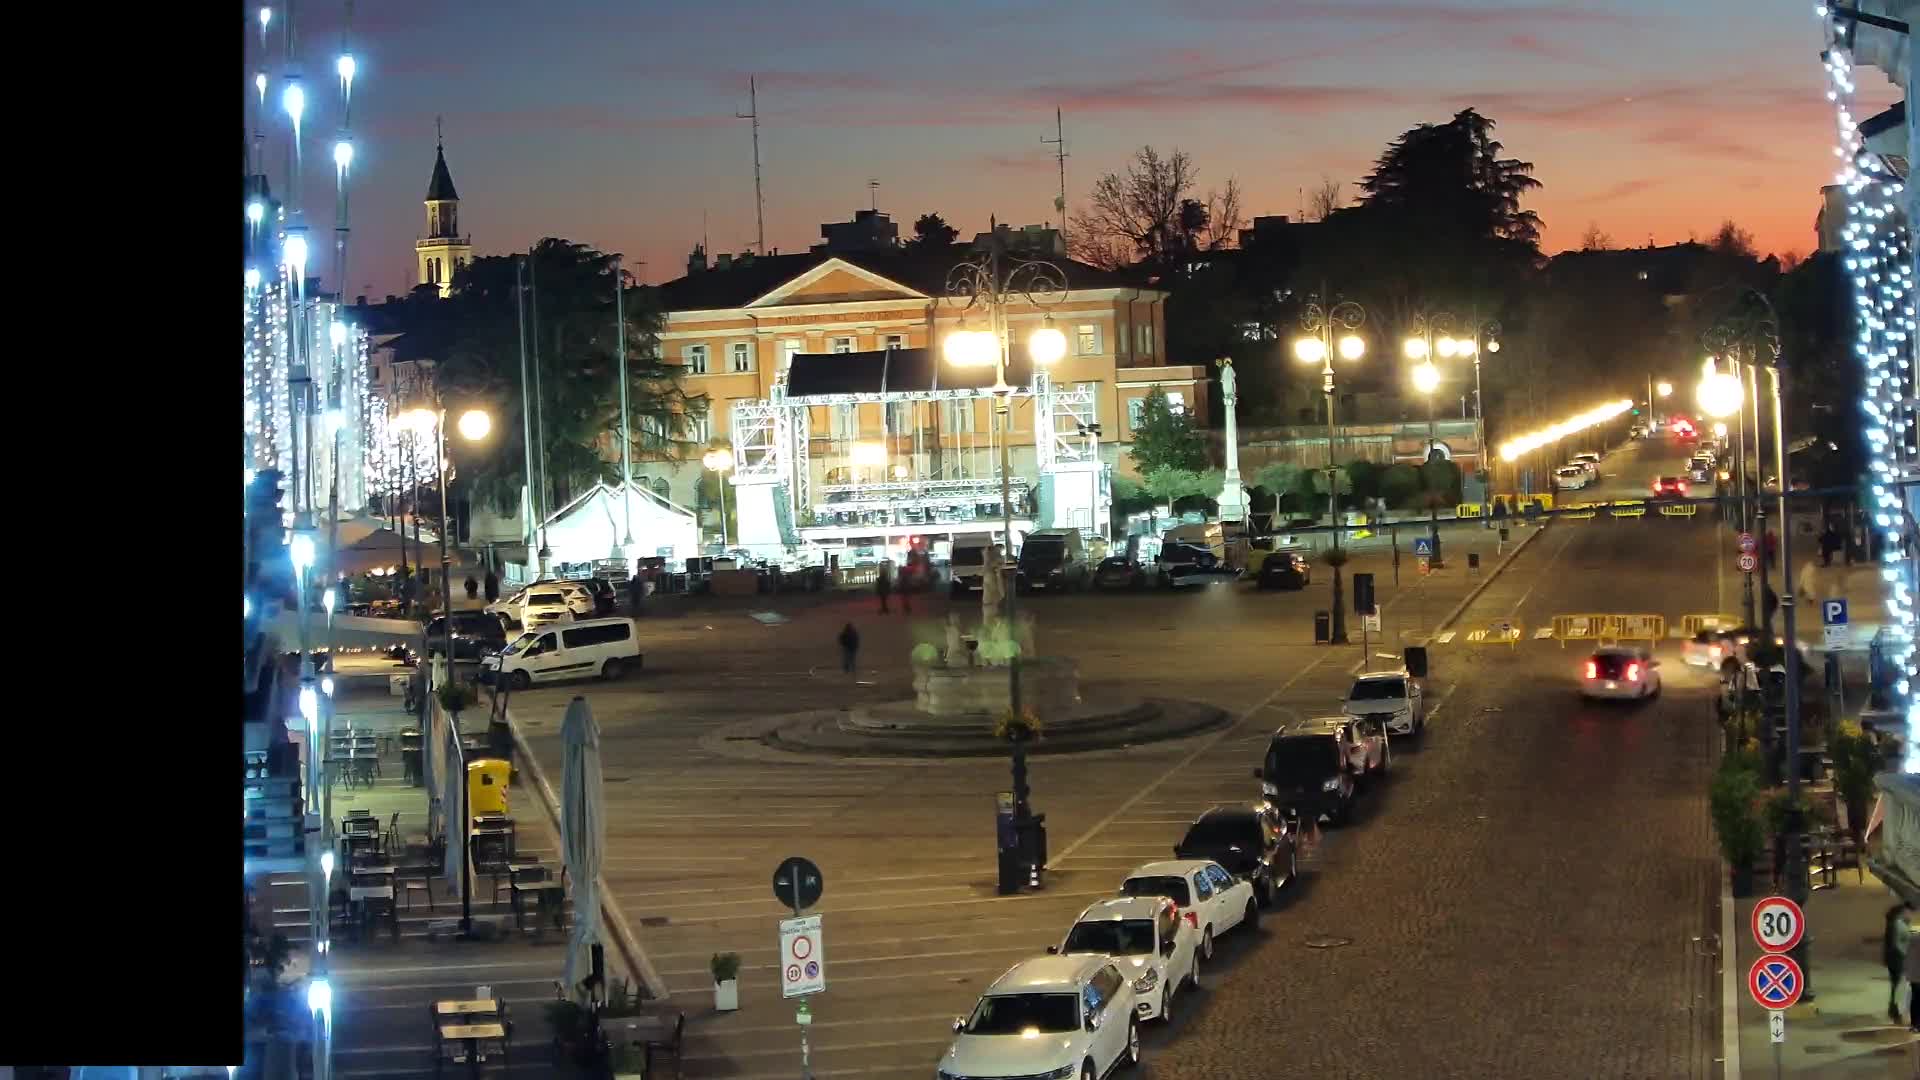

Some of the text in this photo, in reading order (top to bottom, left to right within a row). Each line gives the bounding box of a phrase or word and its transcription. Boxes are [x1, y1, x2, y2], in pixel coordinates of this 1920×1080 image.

[1742, 557, 1753, 567] 20
[1826, 601, 1842, 622] P
[1762, 912, 1792, 938] 30
